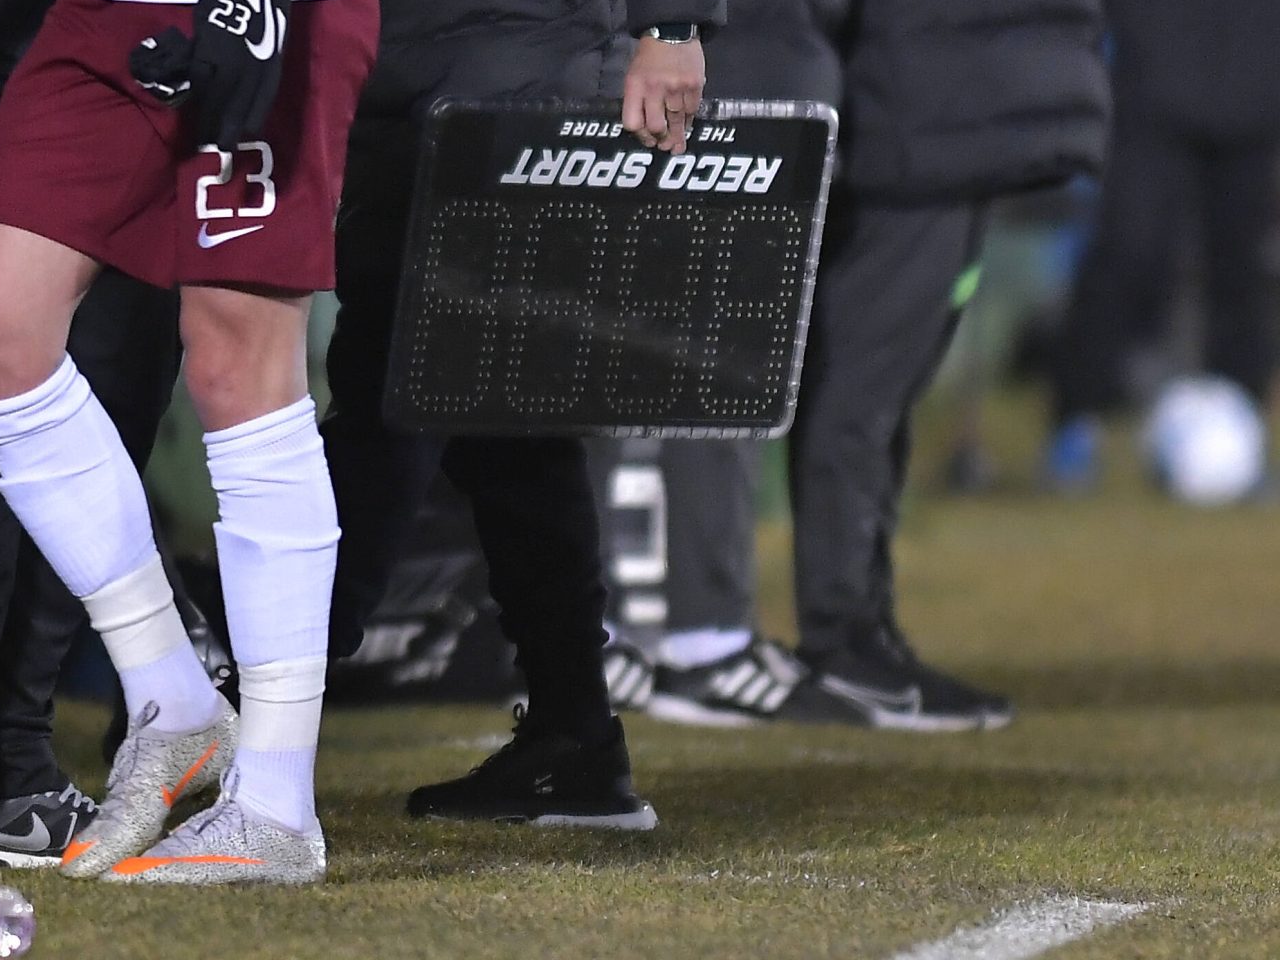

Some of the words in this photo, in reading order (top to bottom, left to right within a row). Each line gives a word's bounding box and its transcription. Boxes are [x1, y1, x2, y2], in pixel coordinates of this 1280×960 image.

[559, 121, 624, 138] STORE
[698, 127, 736, 143] THE
[195, 140, 277, 219] 23
[499, 147, 653, 188] SPORT
[658, 153, 783, 193] RECO
